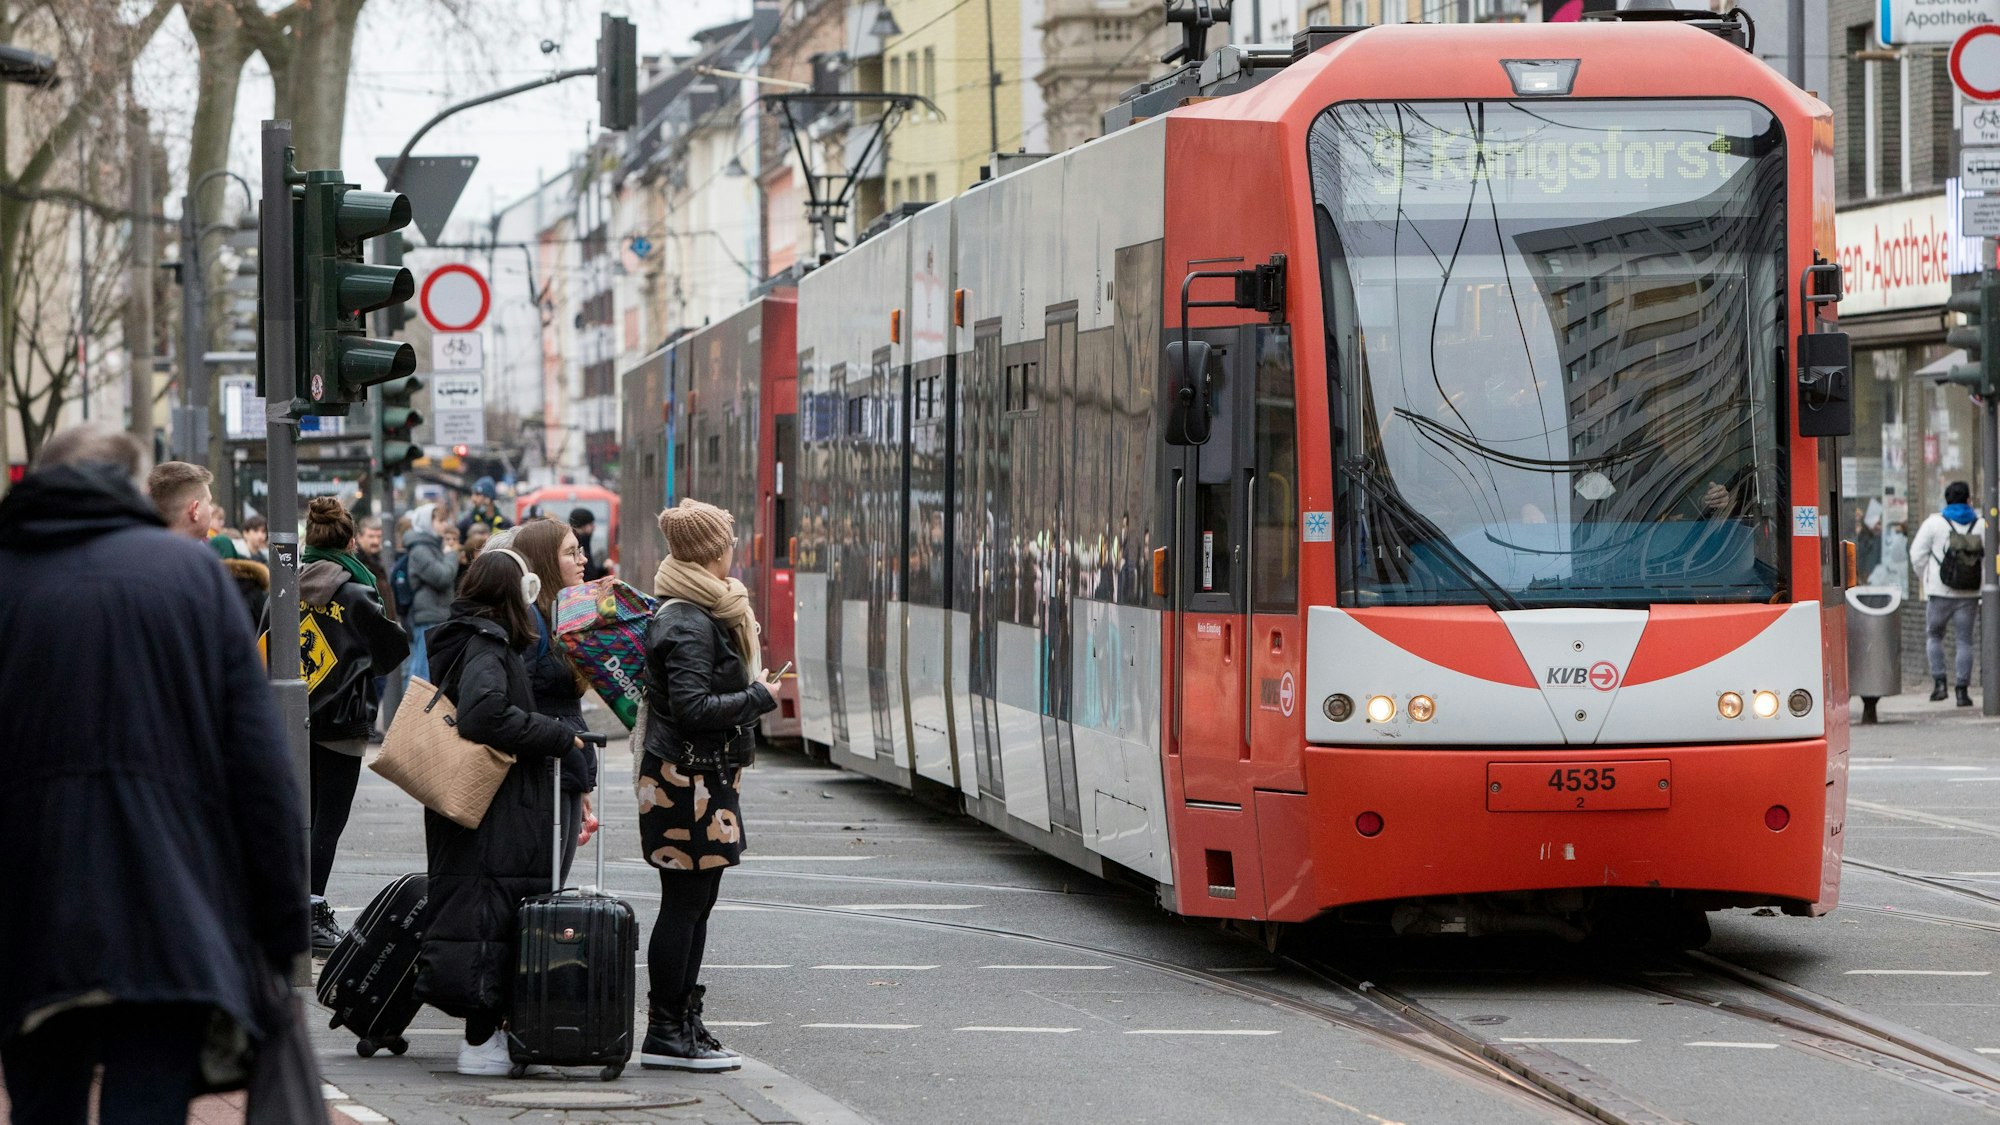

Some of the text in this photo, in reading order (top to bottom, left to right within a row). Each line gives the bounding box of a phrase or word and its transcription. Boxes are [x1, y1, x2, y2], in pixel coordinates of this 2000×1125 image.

[1905, 11, 1988, 29] Apotheke
[1981, 130, 1999, 140] frei
[1431, 125, 1732, 194] Königsforst
[1981, 177, 1999, 186] frei
[1836, 214, 1950, 306] en-Apotheke
[1546, 667, 1588, 684] KVB
[1548, 768, 1616, 792] 4535
[1576, 797, 1585, 808] 2
[356, 942, 397, 994] TRAVELLER
